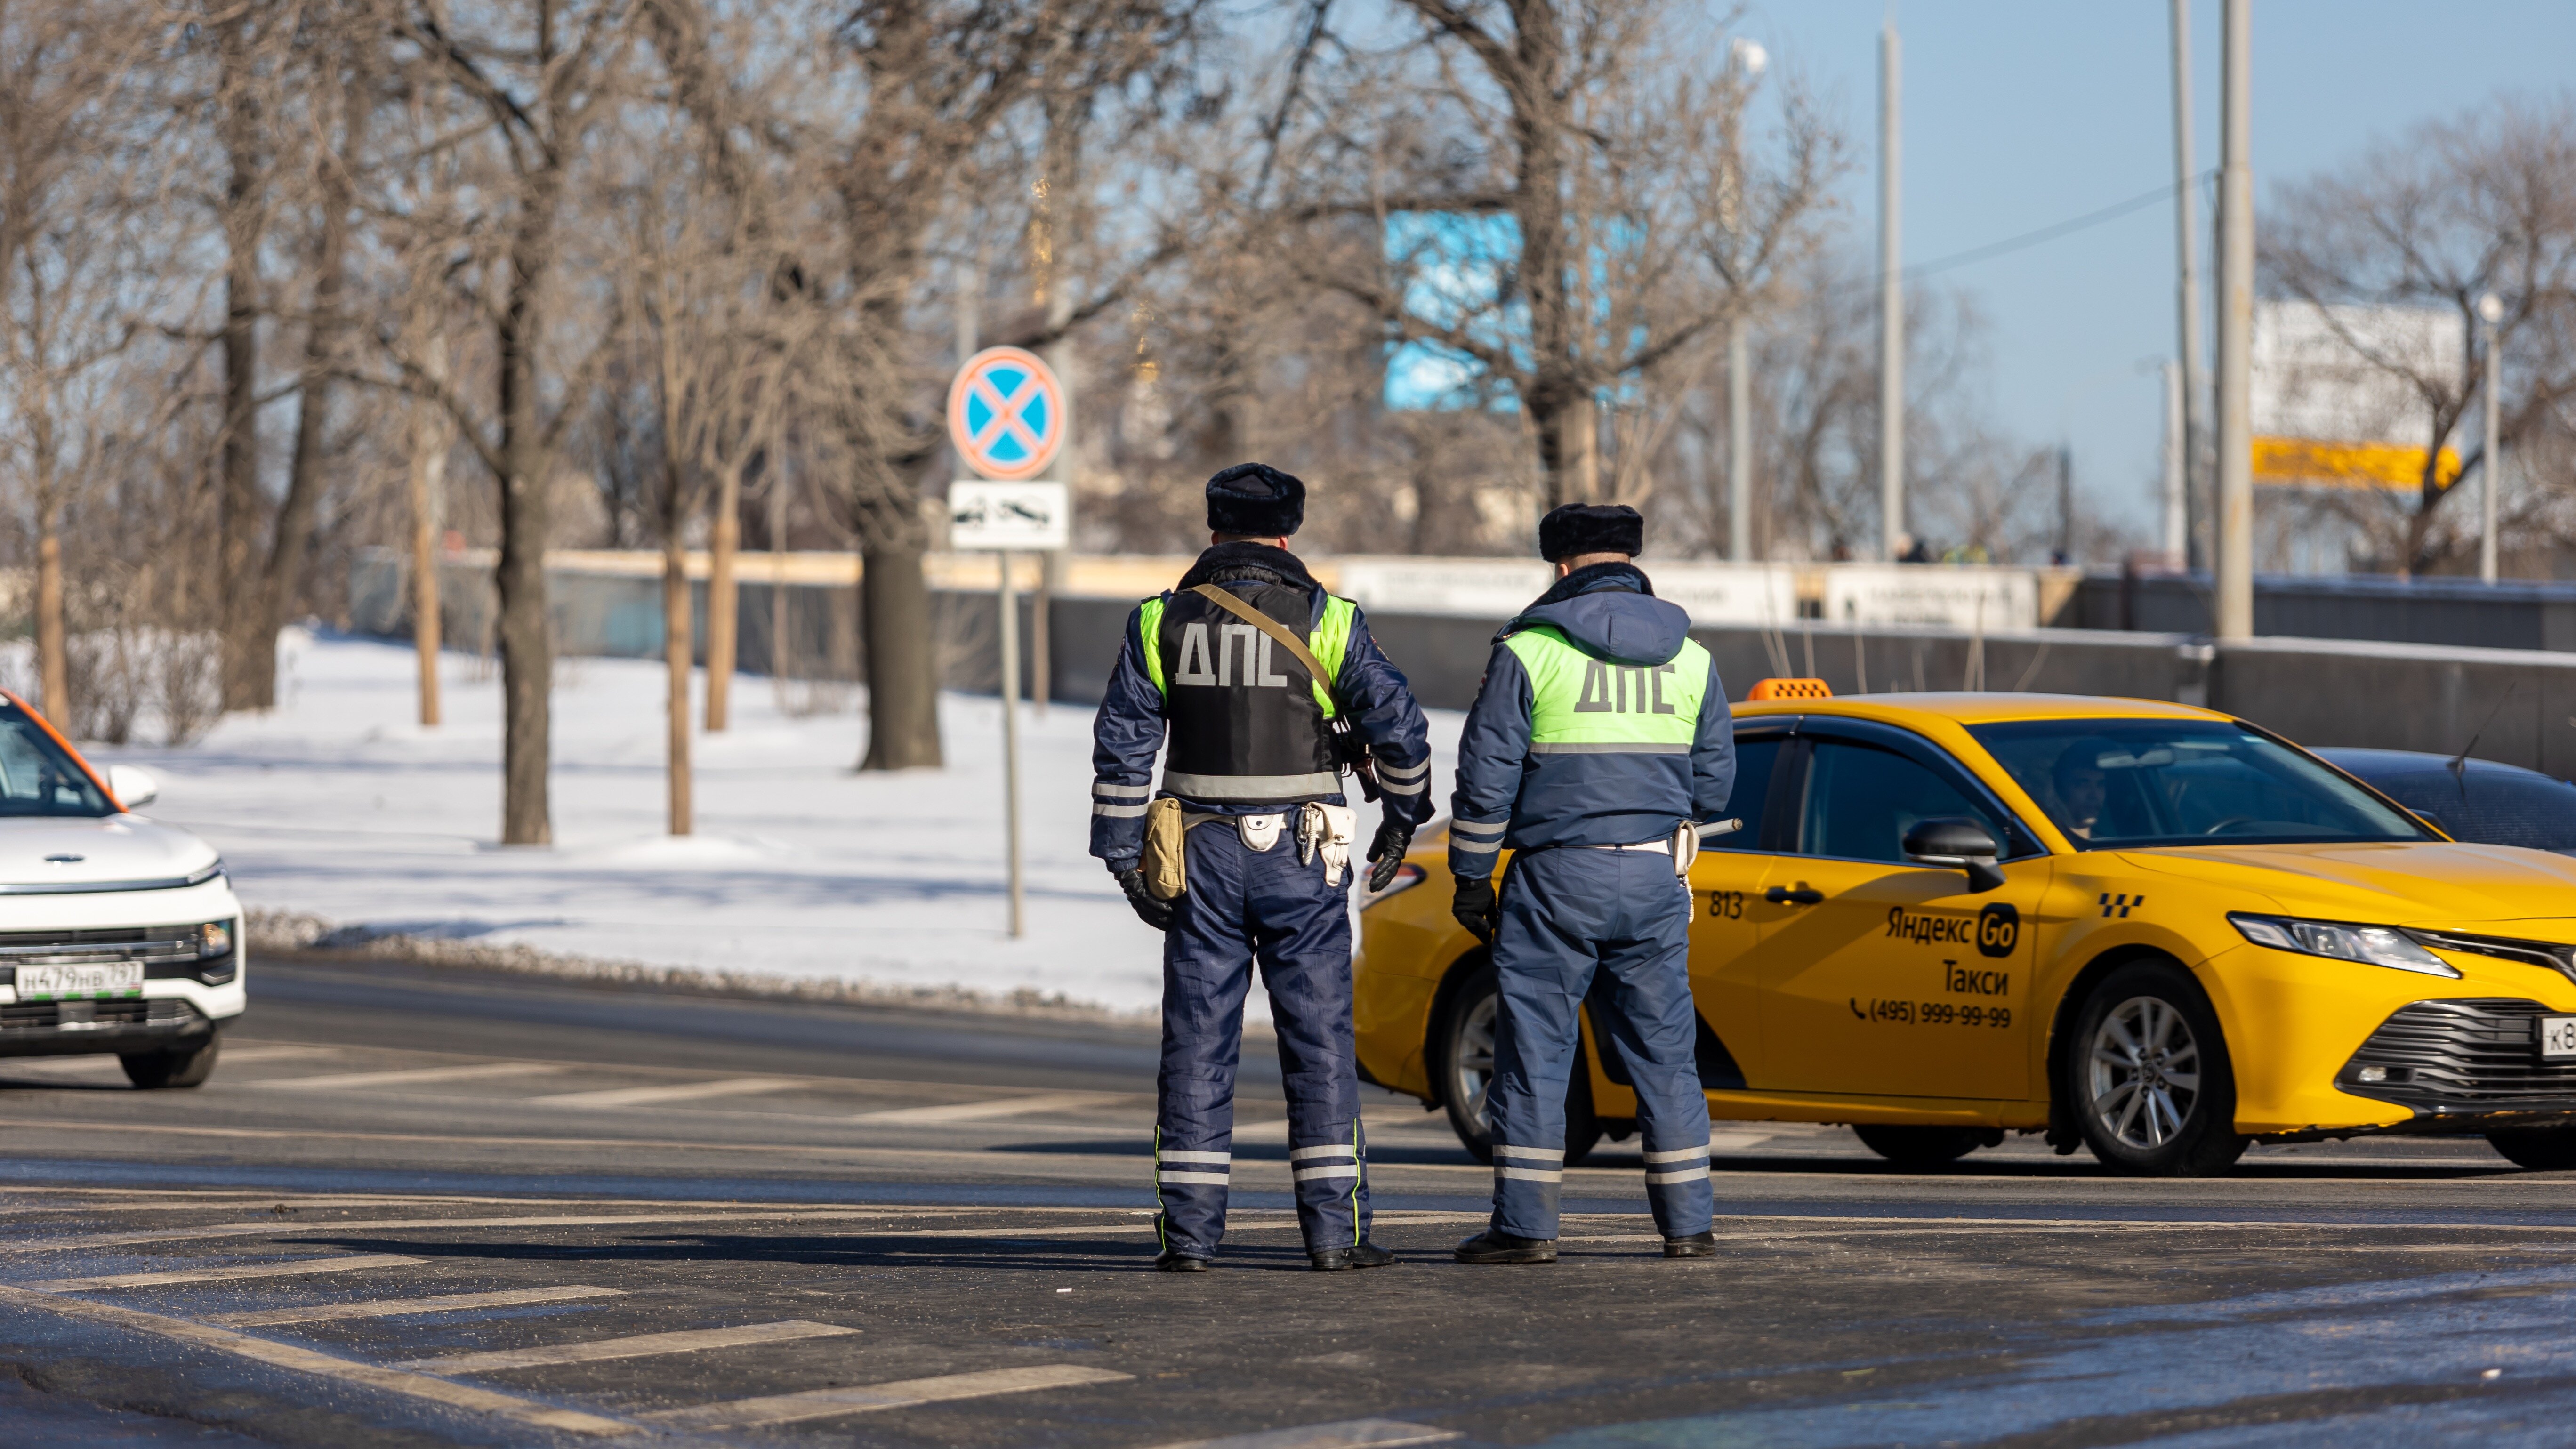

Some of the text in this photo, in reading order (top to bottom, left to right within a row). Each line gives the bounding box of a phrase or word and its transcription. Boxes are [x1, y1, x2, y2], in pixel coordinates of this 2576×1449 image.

[1175, 623, 1289, 687] ДПС
[1574, 659, 1675, 715] ДПС
[1710, 890, 1743, 919] 813
[1886, 906, 2016, 947] Яндекс Go
[1943, 959, 2009, 996] Такси
[1870, 998, 2012, 1028] (495) 999-99-99
